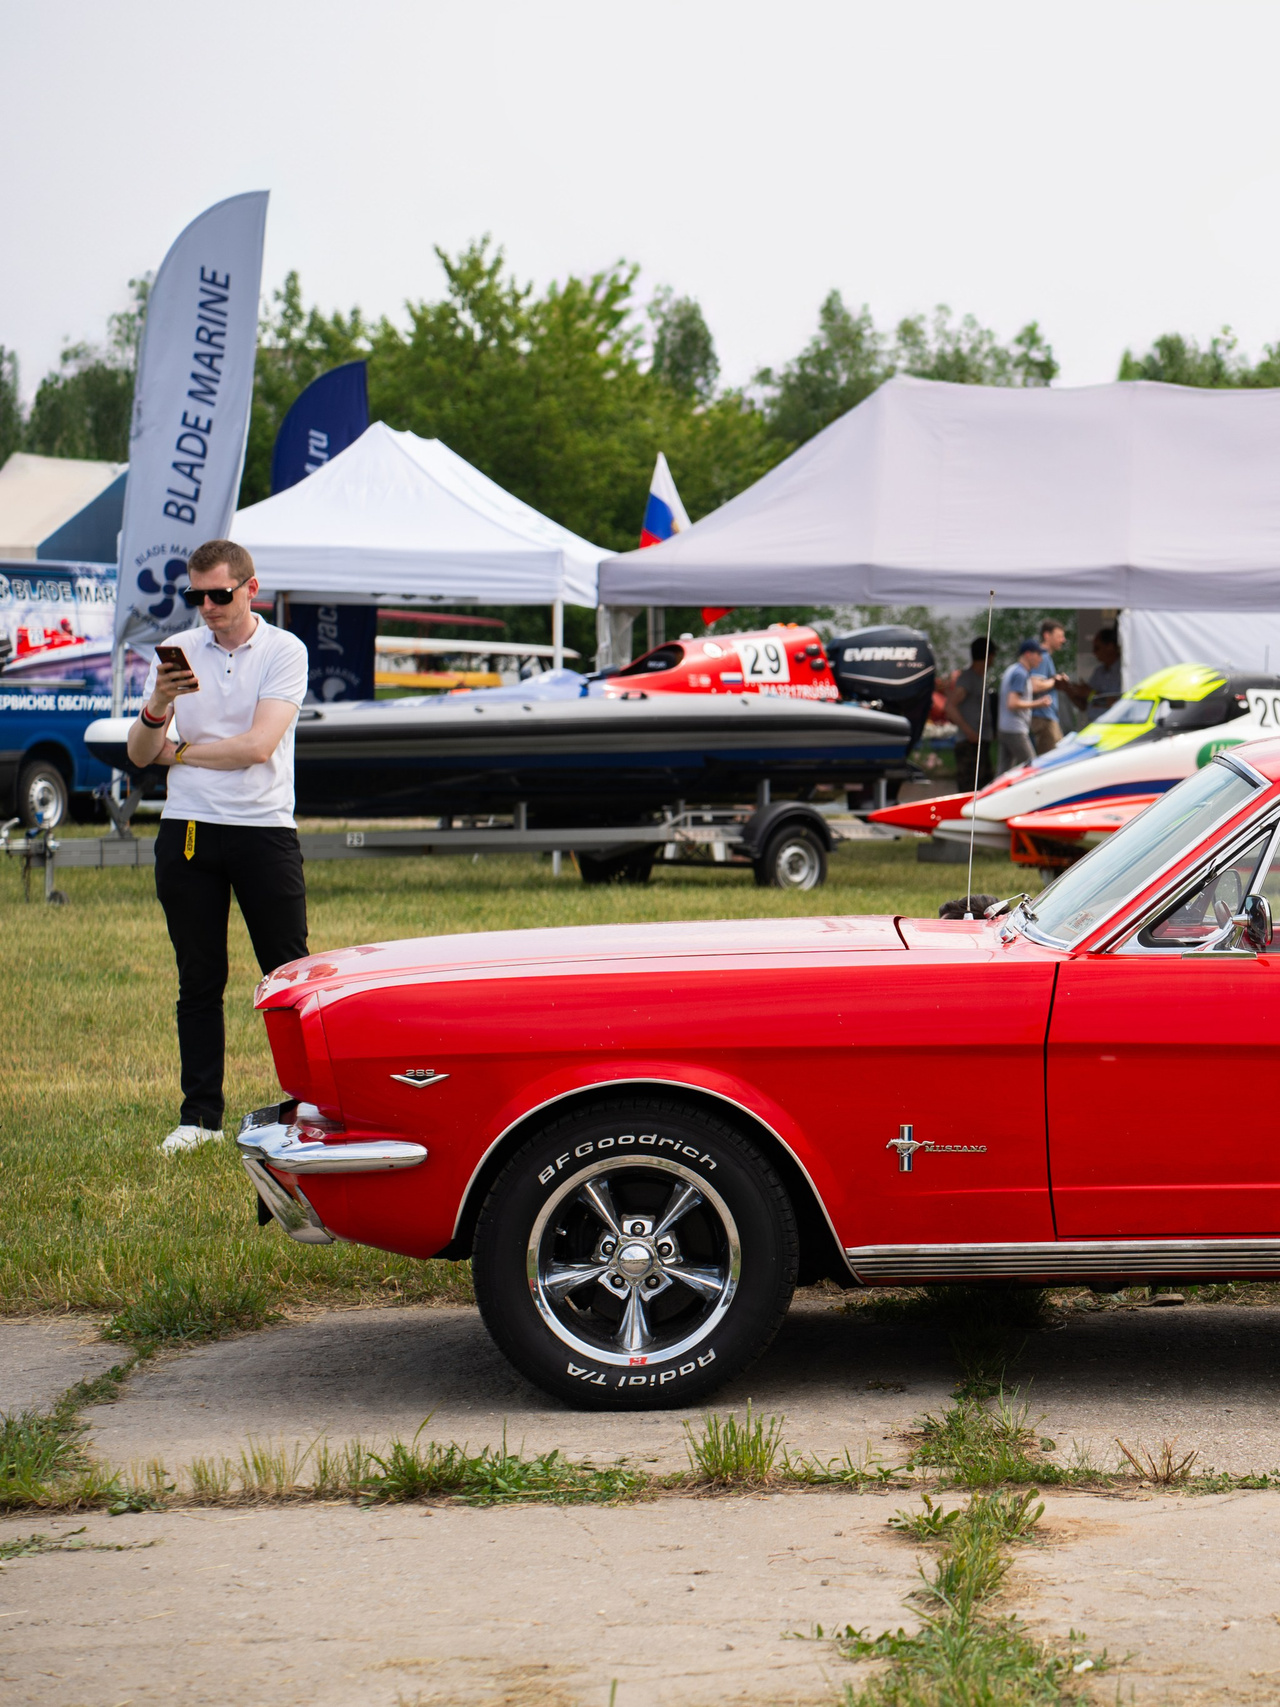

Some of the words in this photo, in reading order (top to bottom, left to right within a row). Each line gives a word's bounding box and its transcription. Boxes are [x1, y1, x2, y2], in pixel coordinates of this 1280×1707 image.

[187, 266, 231, 407] MARINE
[163, 410, 214, 526] BLADE
[135, 544, 167, 566] BLADE
[11, 578, 74, 602] BLADE
[744, 644, 781, 675] 29
[843, 646, 918, 662] EVINRUDE
[0, 694, 57, 710] ЕРВИСНОЕ
[405, 1069, 435, 1077] 289
[537, 1133, 718, 1185] BFGoodrich
[924, 1145, 988, 1153] MUSTANG
[566, 1362, 607, 1386] T/A
[617, 1348, 717, 1388] Radial
